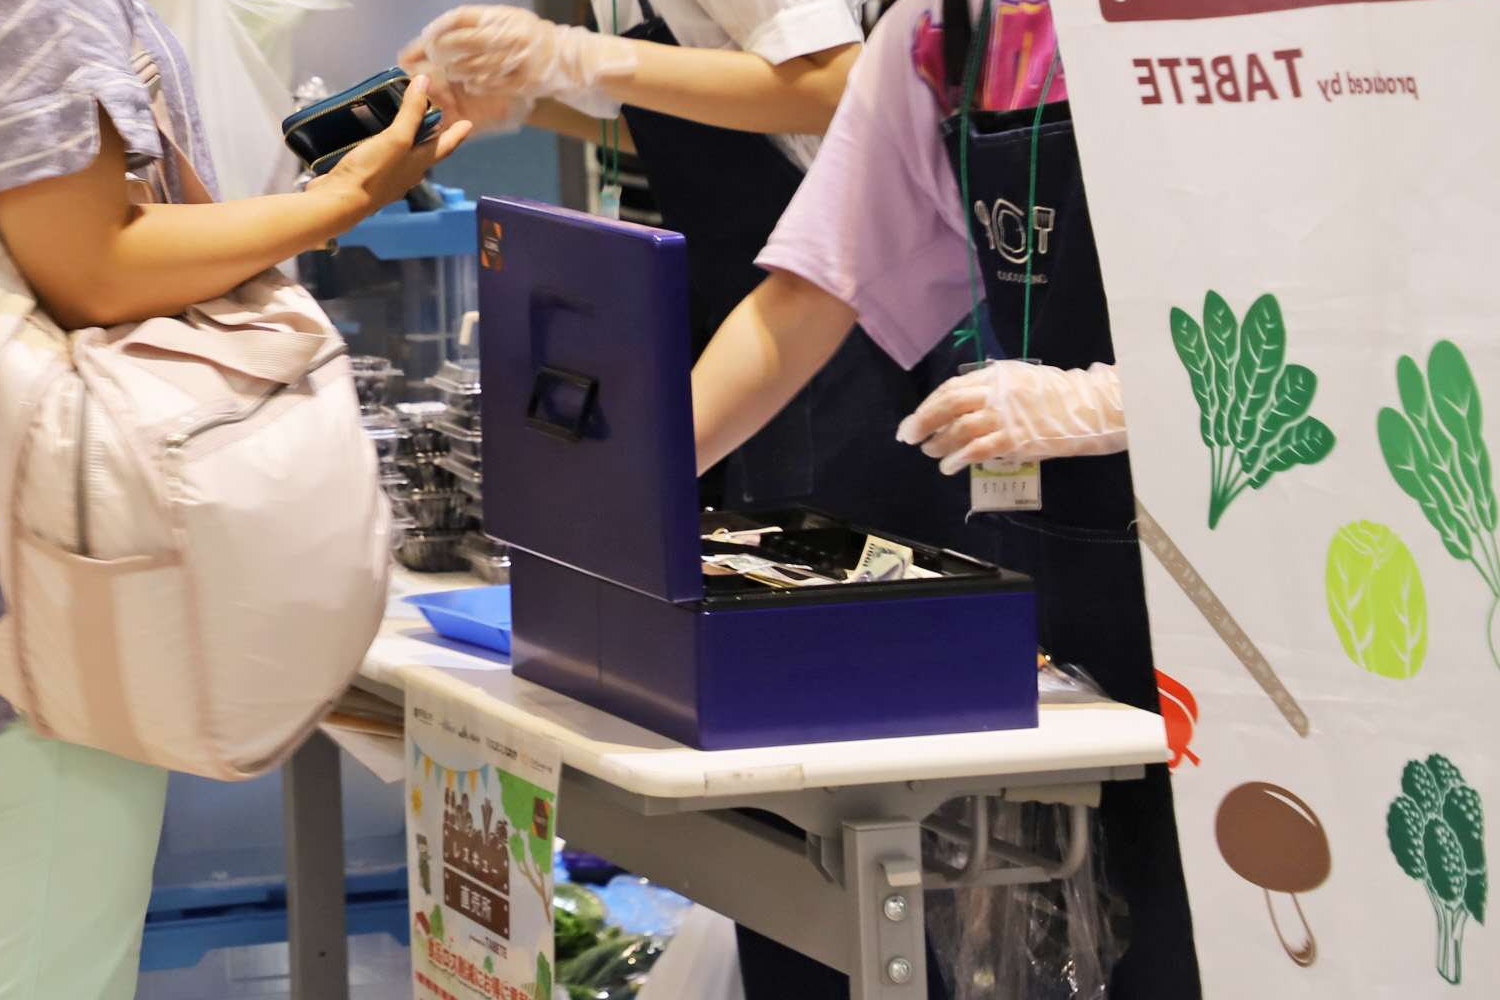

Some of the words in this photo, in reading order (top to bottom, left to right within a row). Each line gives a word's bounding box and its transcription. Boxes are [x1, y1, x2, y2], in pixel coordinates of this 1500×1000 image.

[982, 482, 1027, 494] STAFF
[863, 542, 875, 567] 1000
[452, 841, 499, 875] レスキュー
[459, 884, 492, 923] 直売所
